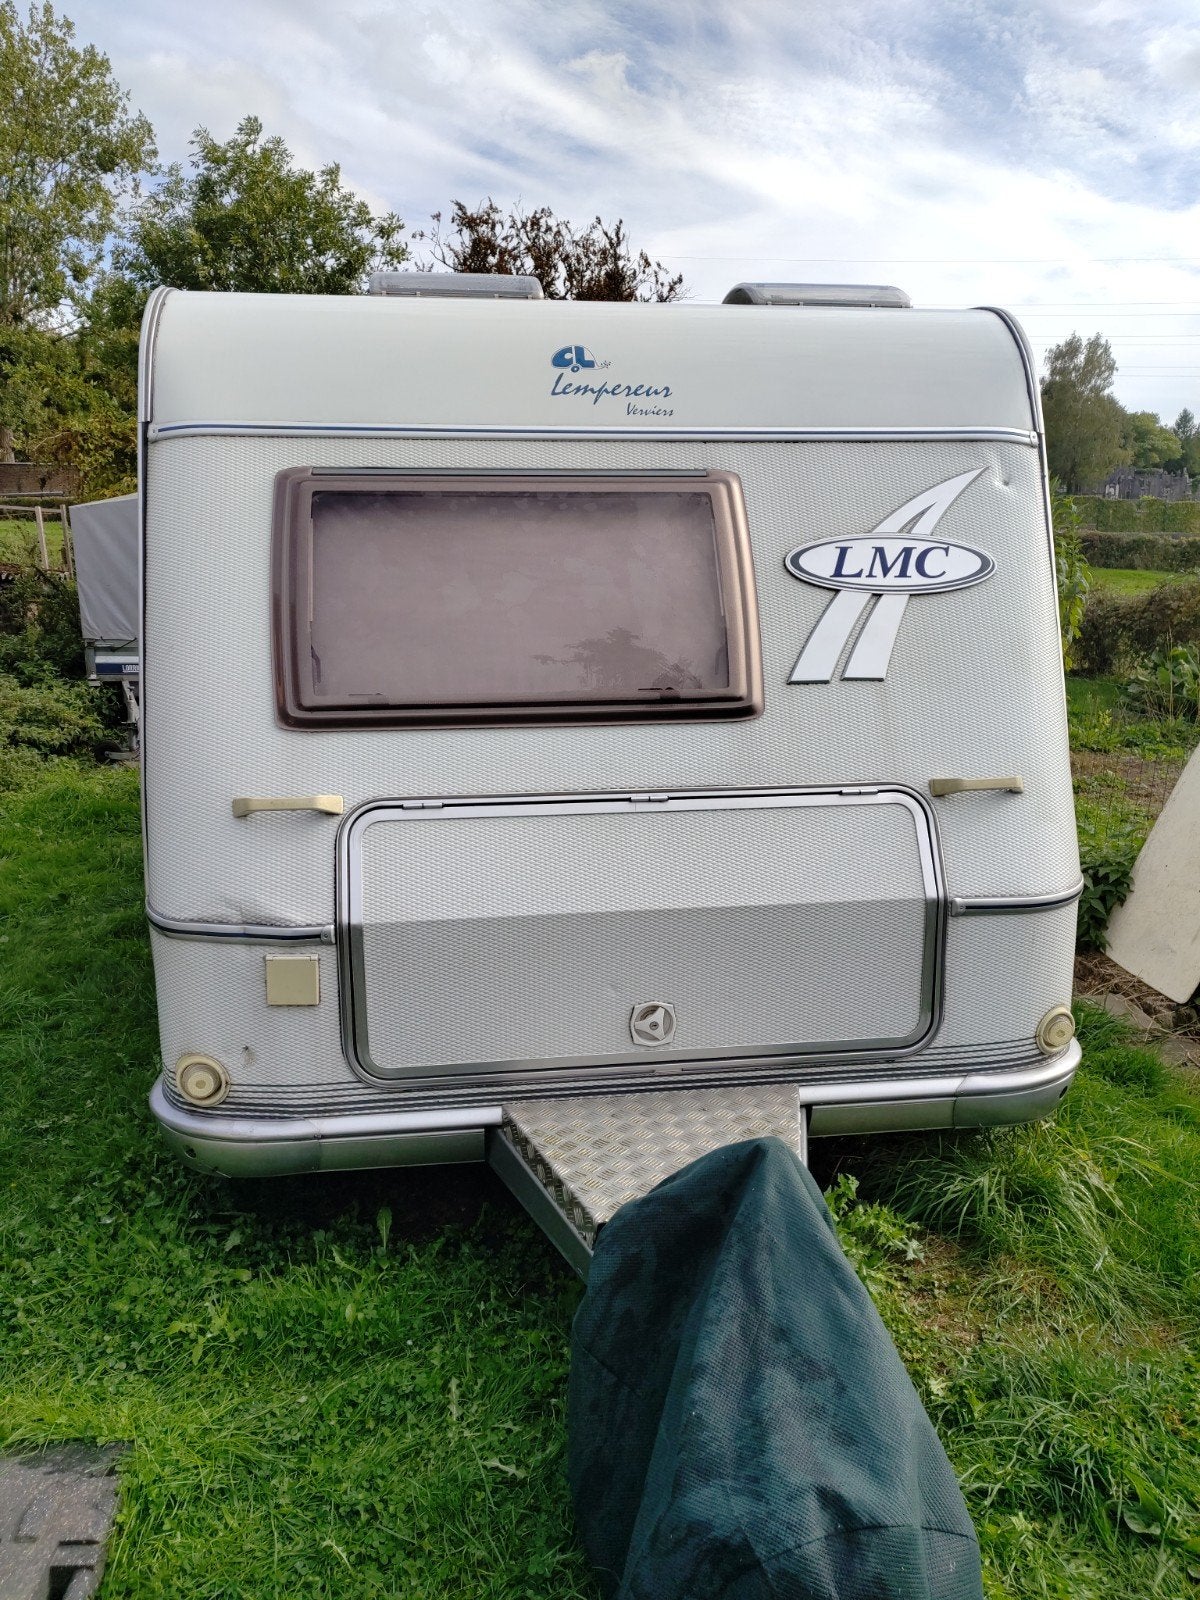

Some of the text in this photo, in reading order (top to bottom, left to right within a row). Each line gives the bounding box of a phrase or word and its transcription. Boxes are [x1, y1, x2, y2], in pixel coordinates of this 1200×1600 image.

[551, 372, 673, 405] Lempereur
[626, 402, 675, 417] Verviers
[829, 545, 951, 579] LMC
